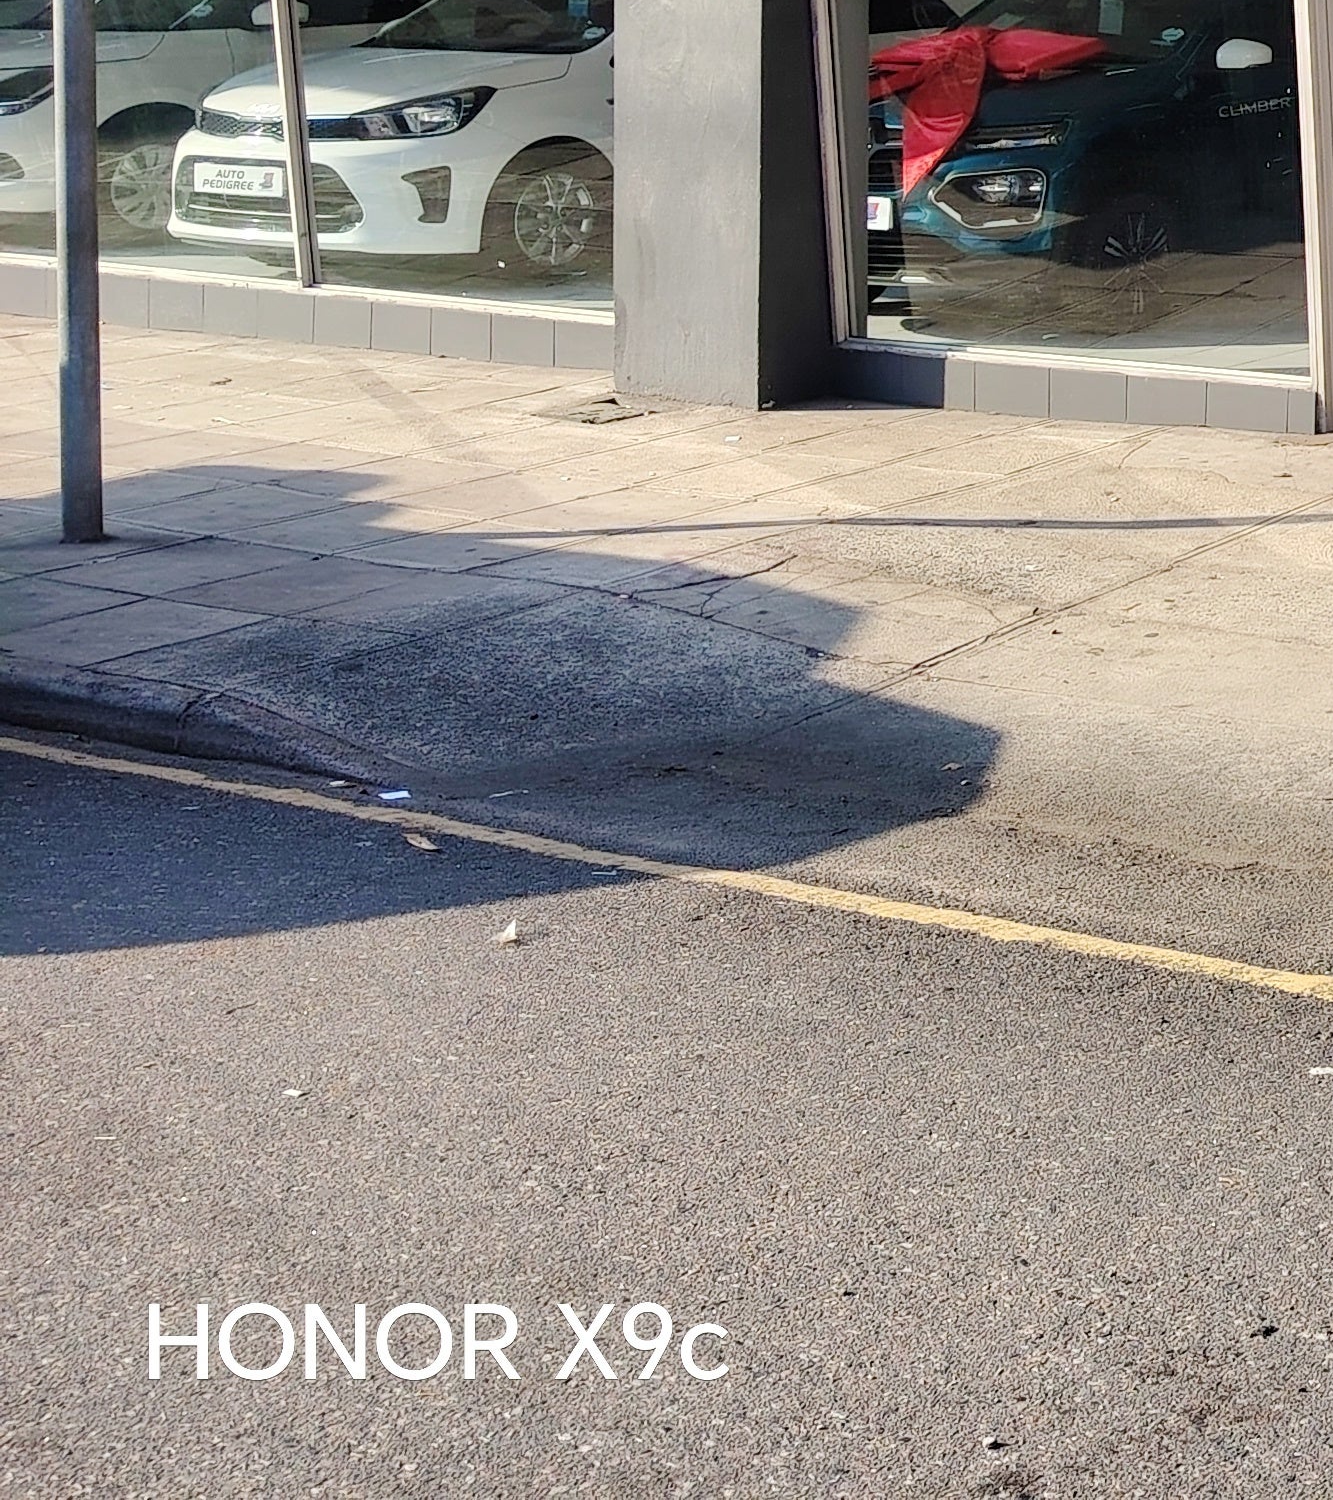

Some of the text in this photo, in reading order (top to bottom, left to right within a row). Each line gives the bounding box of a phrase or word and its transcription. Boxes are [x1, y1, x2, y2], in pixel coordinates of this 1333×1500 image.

[1218, 97, 1293, 118] CLIMBER
[216, 169, 245, 179] AUTO
[202, 179, 254, 191] PEDIGREE
